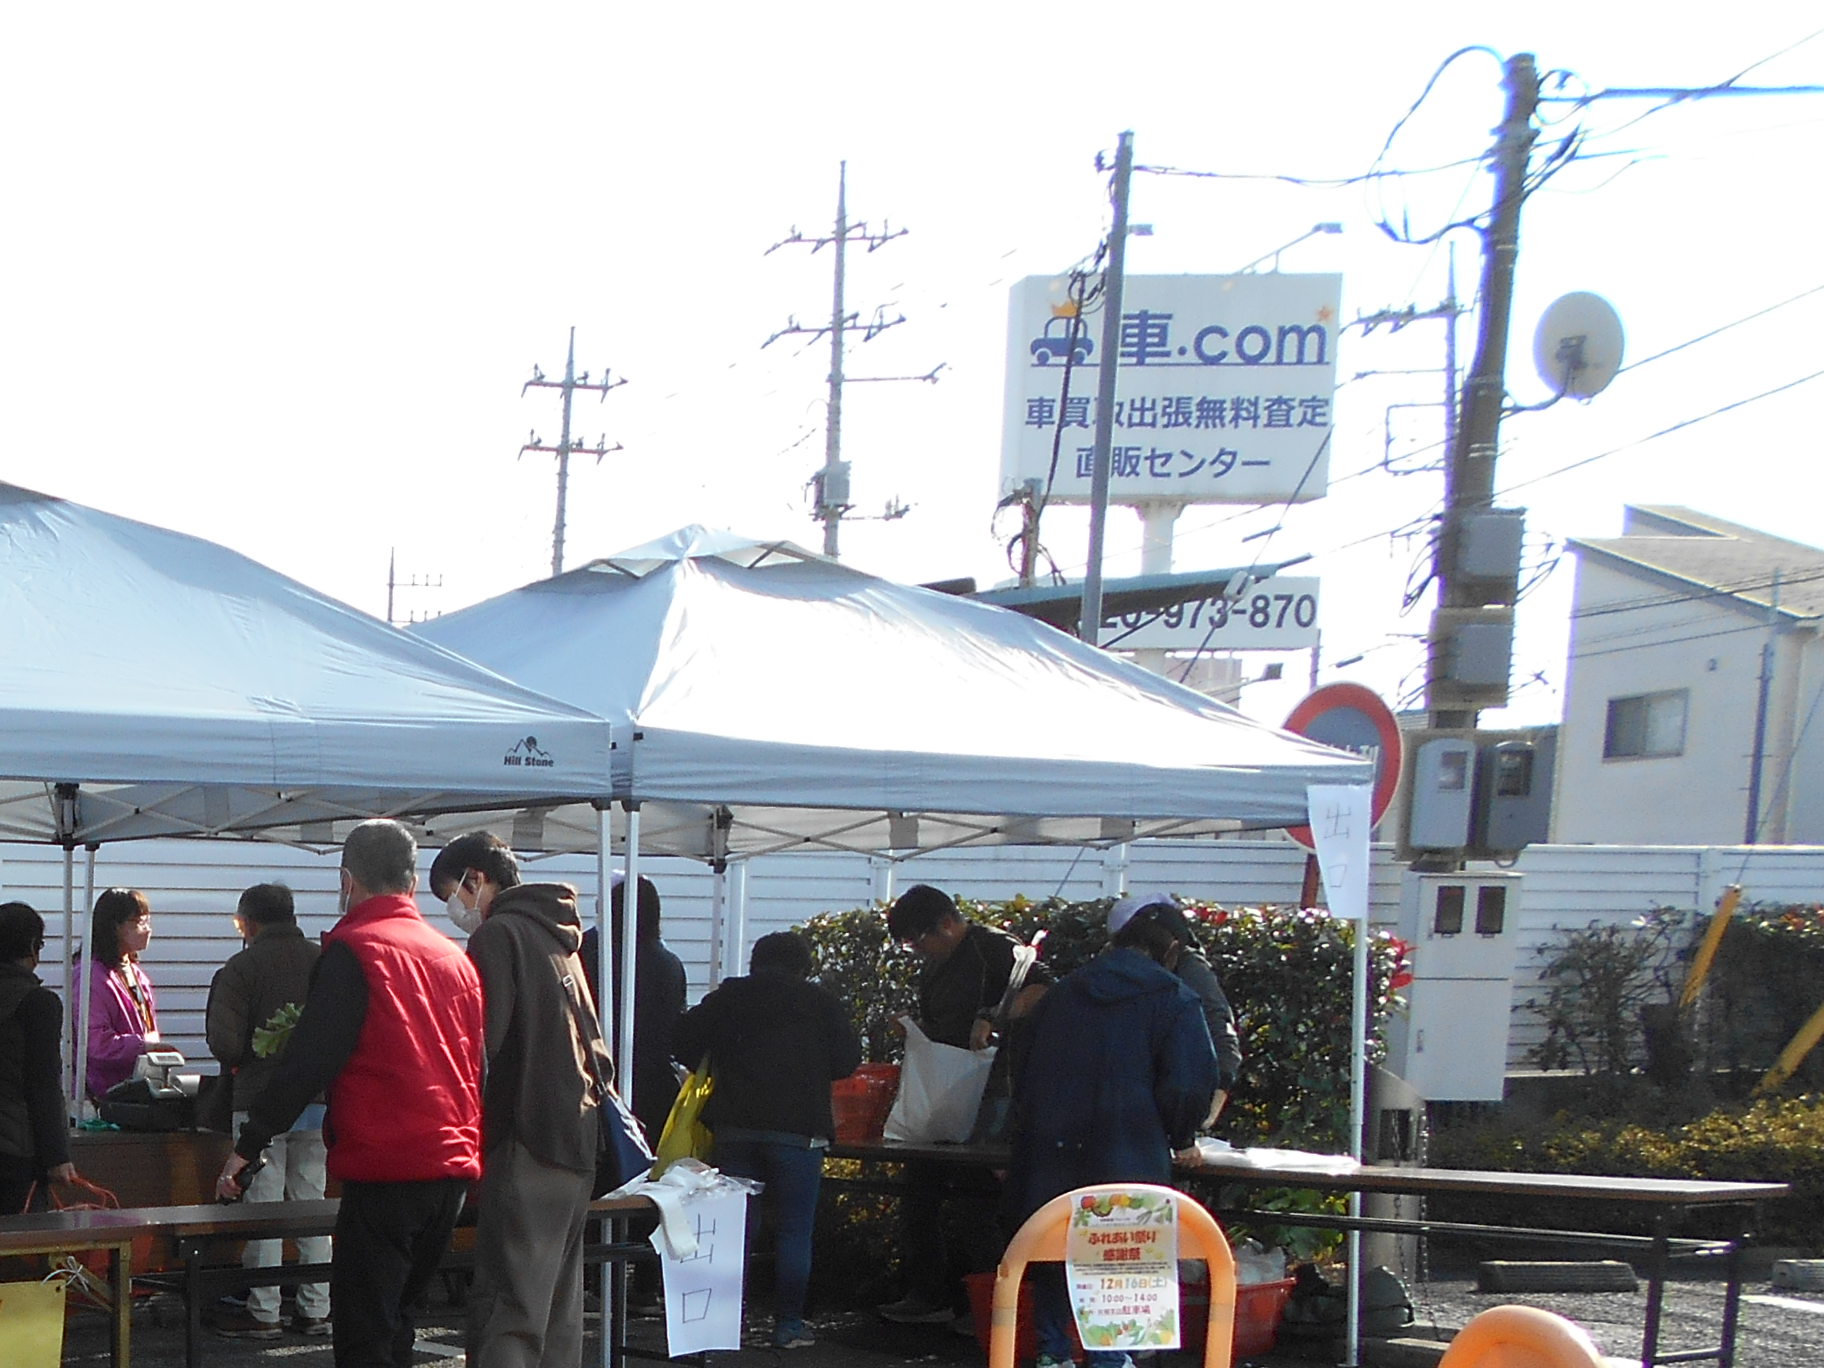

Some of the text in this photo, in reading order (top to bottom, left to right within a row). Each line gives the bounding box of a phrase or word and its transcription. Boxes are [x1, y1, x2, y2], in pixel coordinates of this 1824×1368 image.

[1119, 310, 1328, 365] 車.com
[504, 755, 554, 767] Hill Stone
[1323, 801, 1352, 888] 出口
